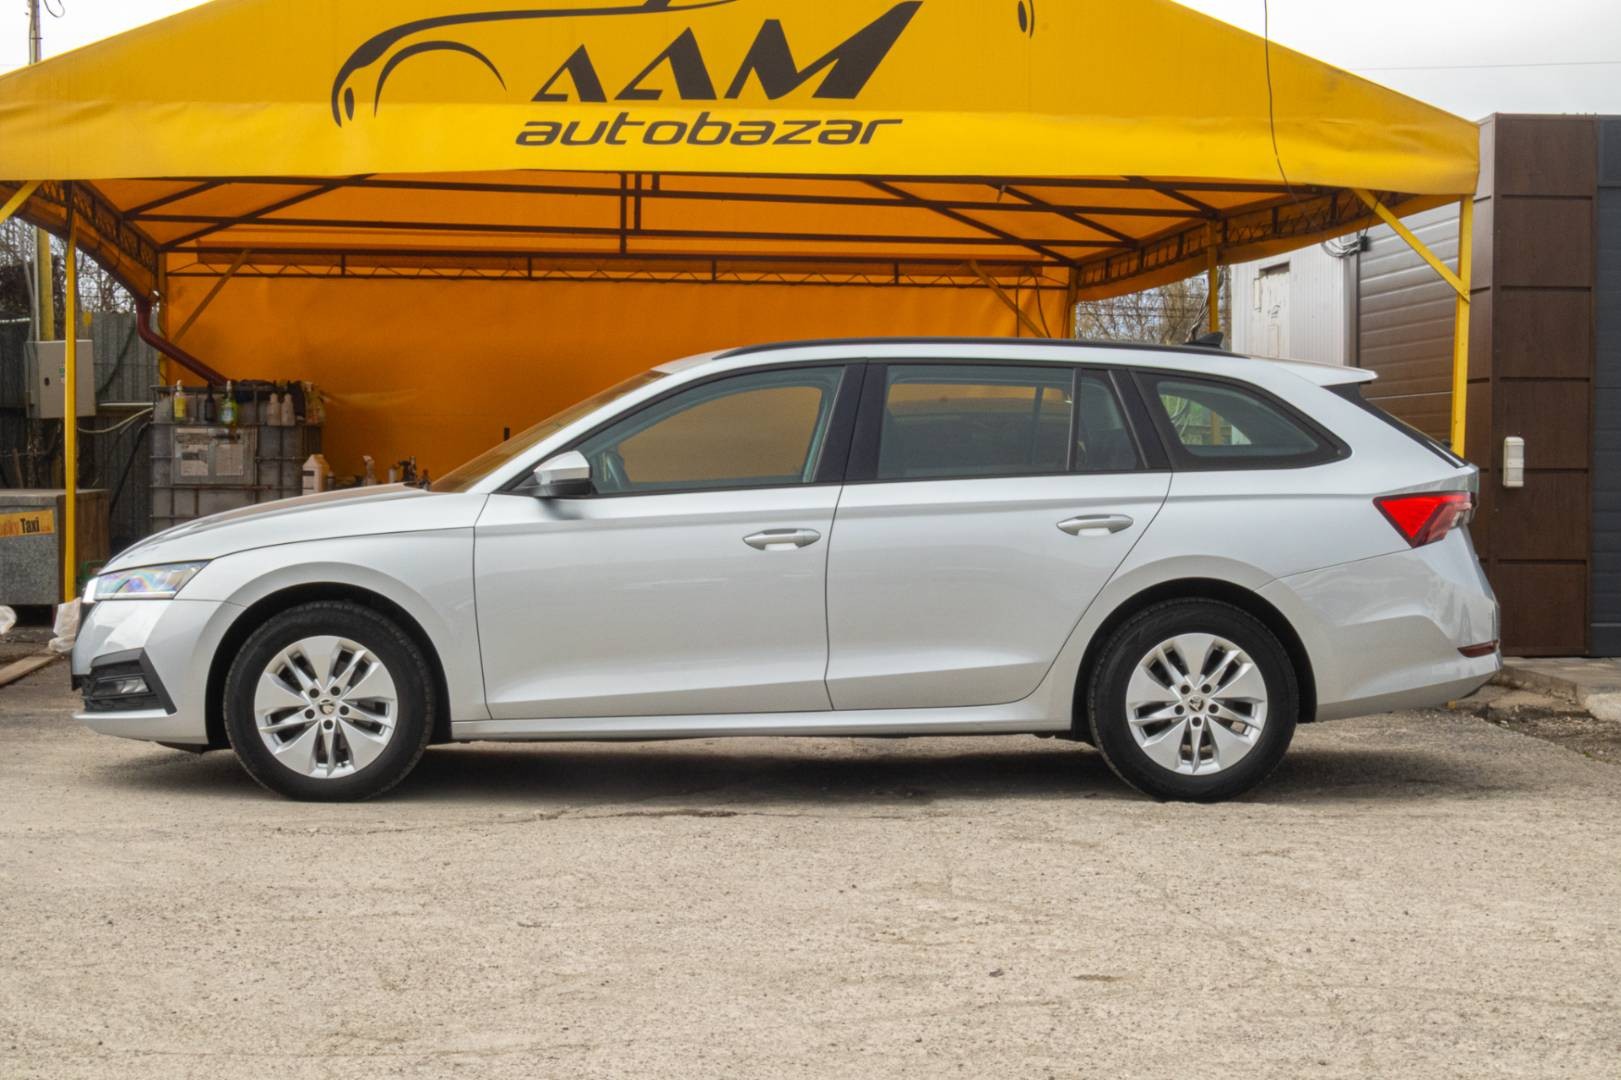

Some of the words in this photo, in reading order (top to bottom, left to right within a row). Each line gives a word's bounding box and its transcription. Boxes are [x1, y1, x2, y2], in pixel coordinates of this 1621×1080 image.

[531, 1, 924, 103] AAM
[515, 112, 903, 146] autobazar
[20, 516, 40, 534] Taxi
